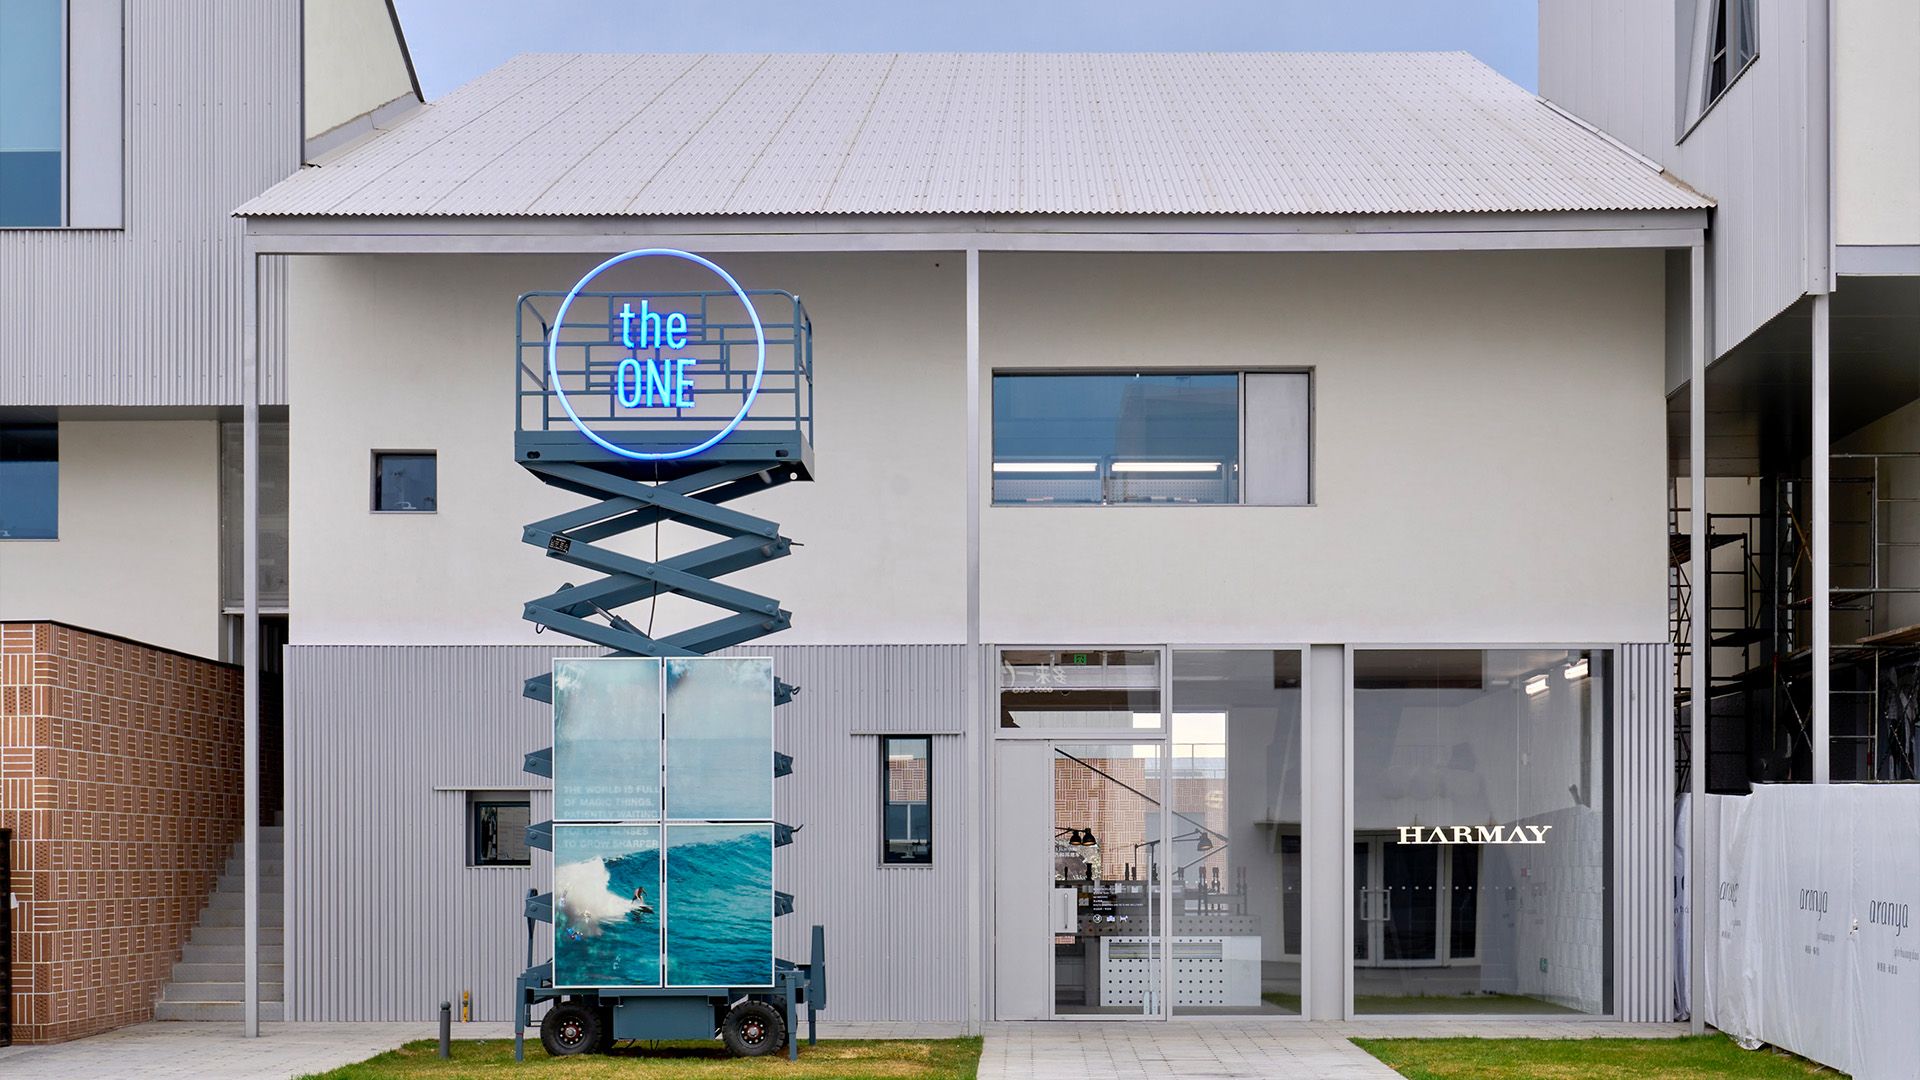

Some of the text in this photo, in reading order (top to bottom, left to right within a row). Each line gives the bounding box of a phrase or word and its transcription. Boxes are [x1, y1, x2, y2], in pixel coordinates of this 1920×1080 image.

[620, 299, 688, 349] the
[617, 358, 697, 408] ONE
[563, 785, 660, 794] THE WORLD IS FULL
[563, 798, 577, 807] OF
[580, 798, 612, 807] MAGIC
[563, 810, 616, 818] PATIENTLY
[1397, 825, 1553, 845] HARMAY
[563, 839, 659, 849] TO GROW SHARPER
[1869, 899, 1909, 937] aranya
